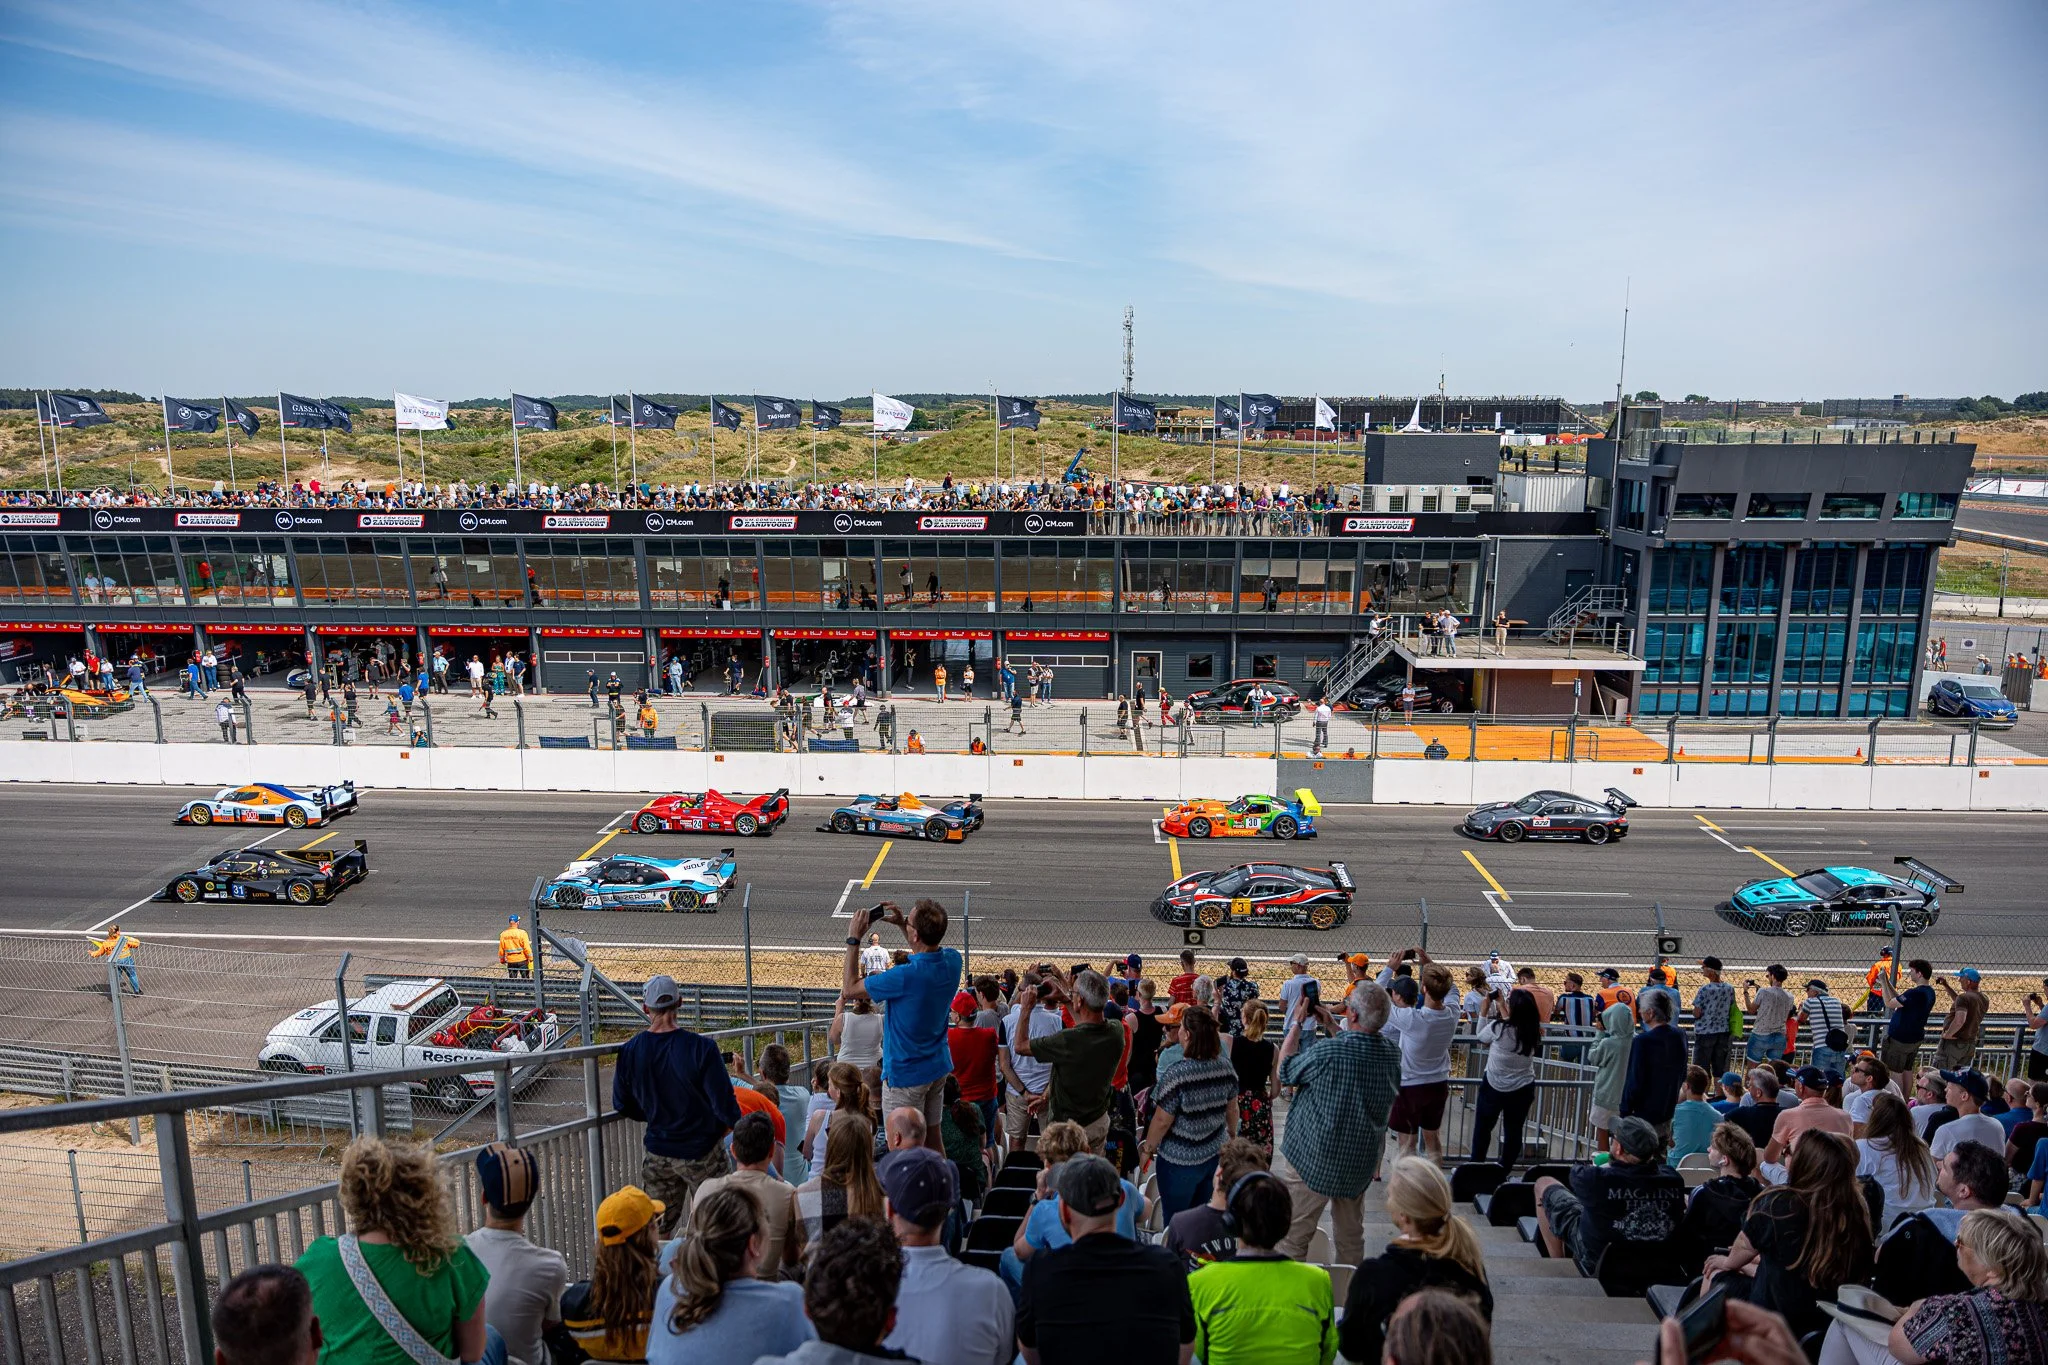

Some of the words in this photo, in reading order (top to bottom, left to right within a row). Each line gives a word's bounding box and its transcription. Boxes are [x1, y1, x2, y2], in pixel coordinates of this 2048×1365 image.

[247, 811, 256, 819] 007
[694, 820, 702, 828] 24
[1249, 818, 1257, 826] 30
[683, 862, 706, 870] WOLF
[233, 885, 244, 895] 31
[587, 897, 598, 906] 52
[1237, 902, 1244, 912] 3
[1850, 910, 1890, 920] vitaphone
